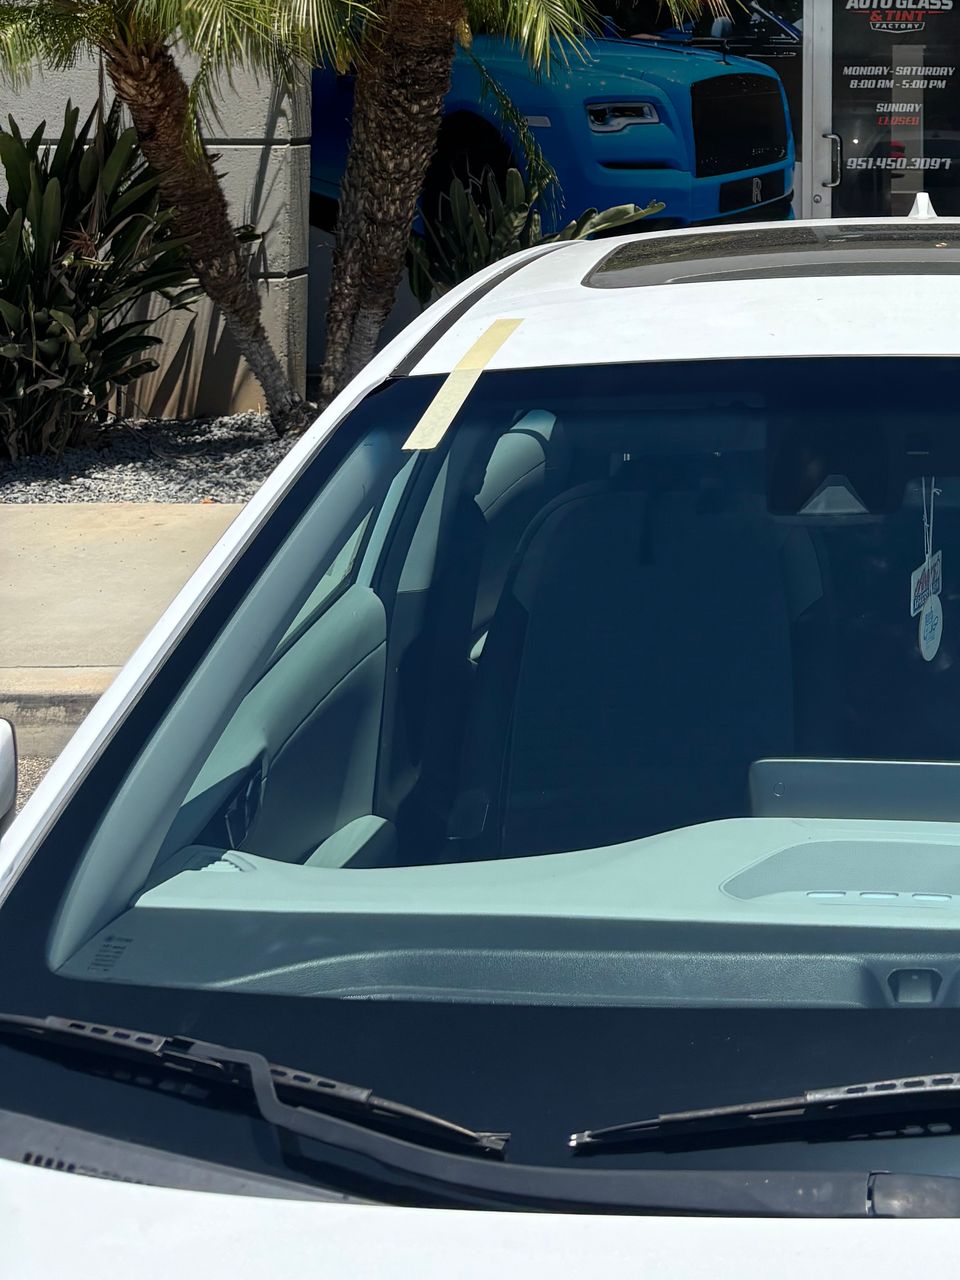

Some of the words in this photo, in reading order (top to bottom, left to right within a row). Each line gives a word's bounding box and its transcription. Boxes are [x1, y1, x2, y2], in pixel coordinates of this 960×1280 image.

[870, 10, 882, 21] &
[885, 10, 926, 21] TINT
[850, 79, 875, 88] 8:00
[877, 79, 894, 88] AM
[902, 79, 927, 88] 5:00
[929, 79, 946, 88] PM
[876, 103, 922, 112] SUNDAY
[877, 116, 919, 125] CLOSED
[846, 157, 952, 170] 951.450.3097
